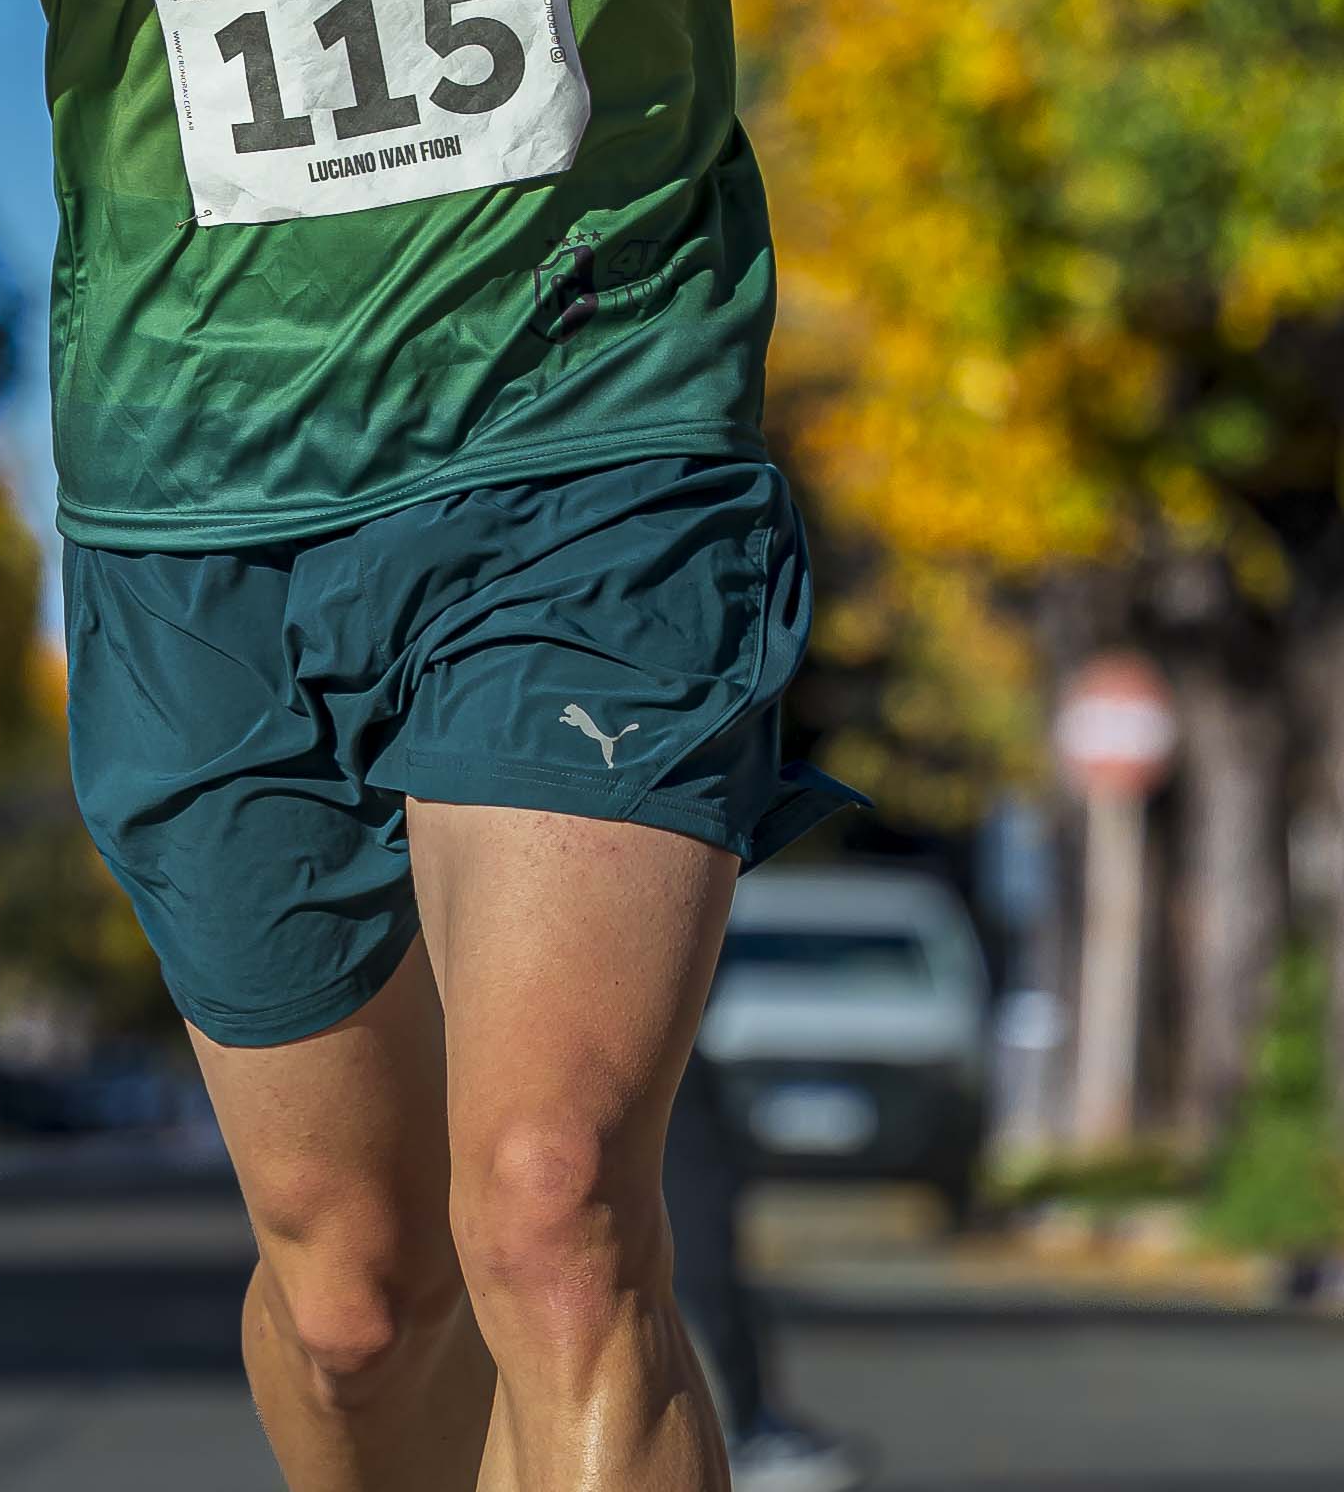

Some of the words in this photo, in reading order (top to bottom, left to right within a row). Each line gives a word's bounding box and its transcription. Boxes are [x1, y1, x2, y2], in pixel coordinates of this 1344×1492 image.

[307, 151, 377, 183] LUCIANO
[378, 143, 418, 170] IVAN
[419, 134, 462, 162] FIORI
